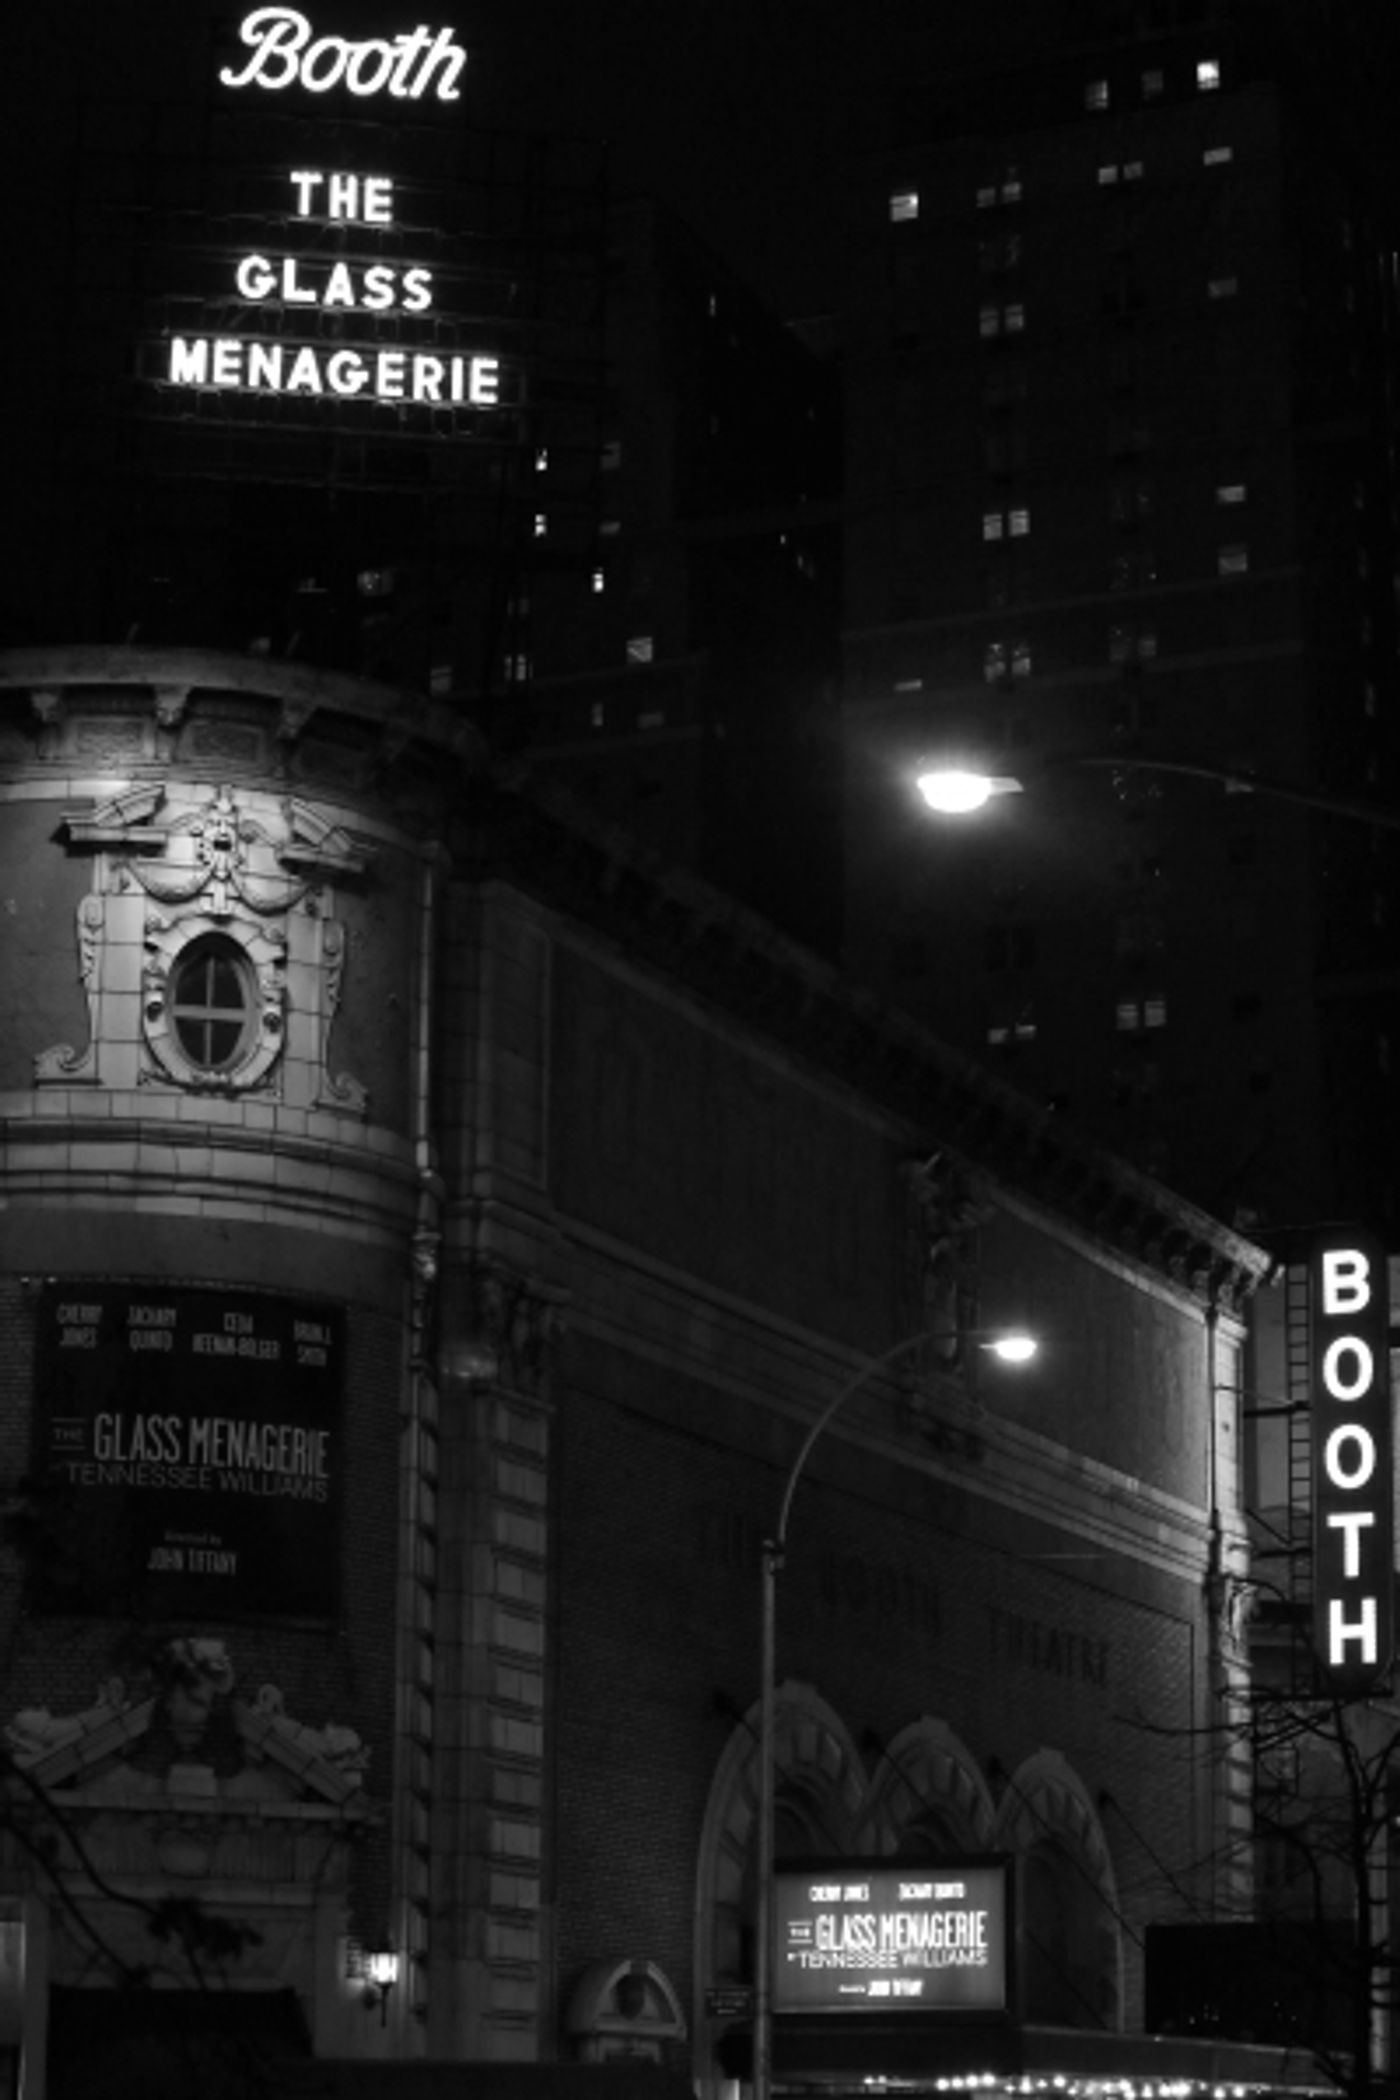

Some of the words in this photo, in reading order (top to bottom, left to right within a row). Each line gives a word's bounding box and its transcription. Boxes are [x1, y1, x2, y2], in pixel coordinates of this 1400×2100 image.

[219, 6, 467, 101] Booth
[290, 170, 394, 223] THE
[235, 254, 434, 310] GLASS
[169, 336, 500, 405] MENAGERIE
[53, 1426, 83, 1443] THE
[93, 1411, 183, 1463] GLASS
[187, 1416, 331, 1480] MENAGERIE
[1321, 1248, 1378, 1666] BOOTH
[67, 1462, 213, 1490] TENNESSEE
[216, 1467, 329, 1503] WILLIAMS
[800, 1951, 898, 1969] TENNESSEE
[901, 1949, 988, 1969] WILLIAMS
[815, 1913, 876, 1951] GLASS
[879, 1911, 988, 1951] MENAGERIE
